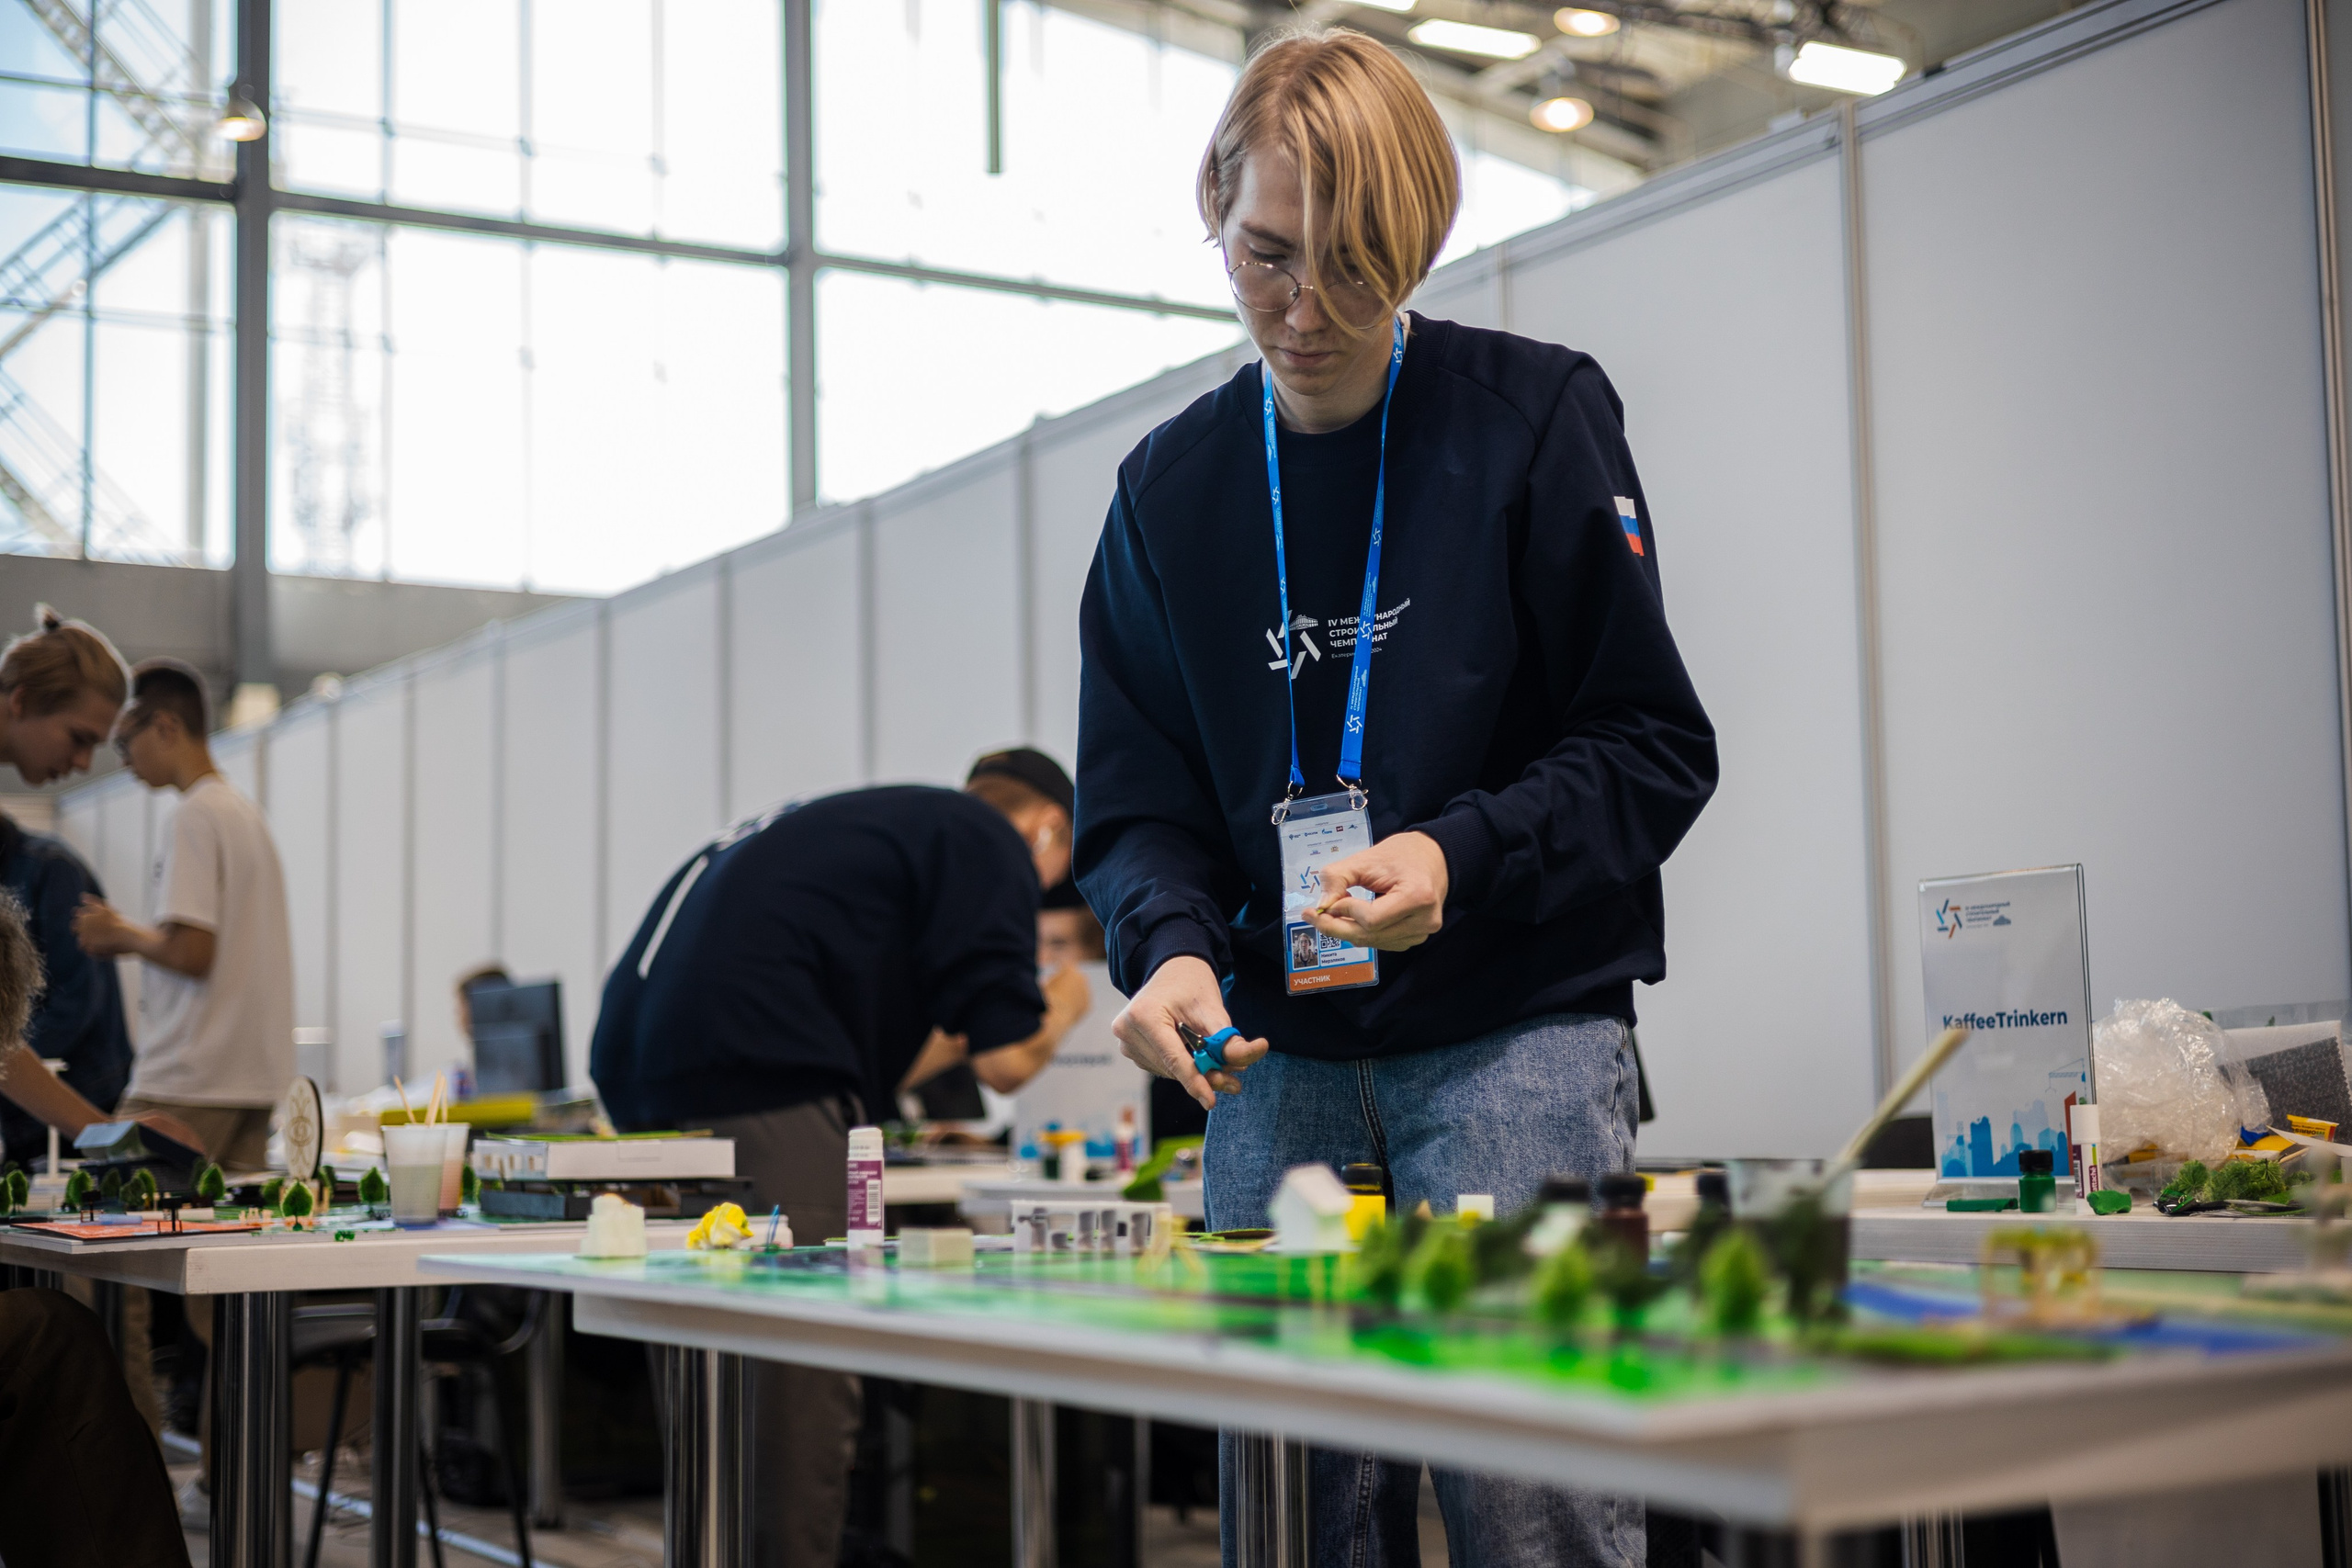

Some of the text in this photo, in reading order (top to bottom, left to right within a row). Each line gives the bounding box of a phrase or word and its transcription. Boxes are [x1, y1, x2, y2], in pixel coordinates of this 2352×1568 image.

[1340, 598, 1410, 625] МЕЖНАРОДНЫЙ
[1329, 616, 1398, 637] СТРОИЛЬНЫЙ
[1329, 632, 1388, 648] ЧЕМПНАТ
[1294, 975, 1330, 987] УЧАСТНИК
[1942, 1009, 2068, 1031] KaffeeTrinkern
